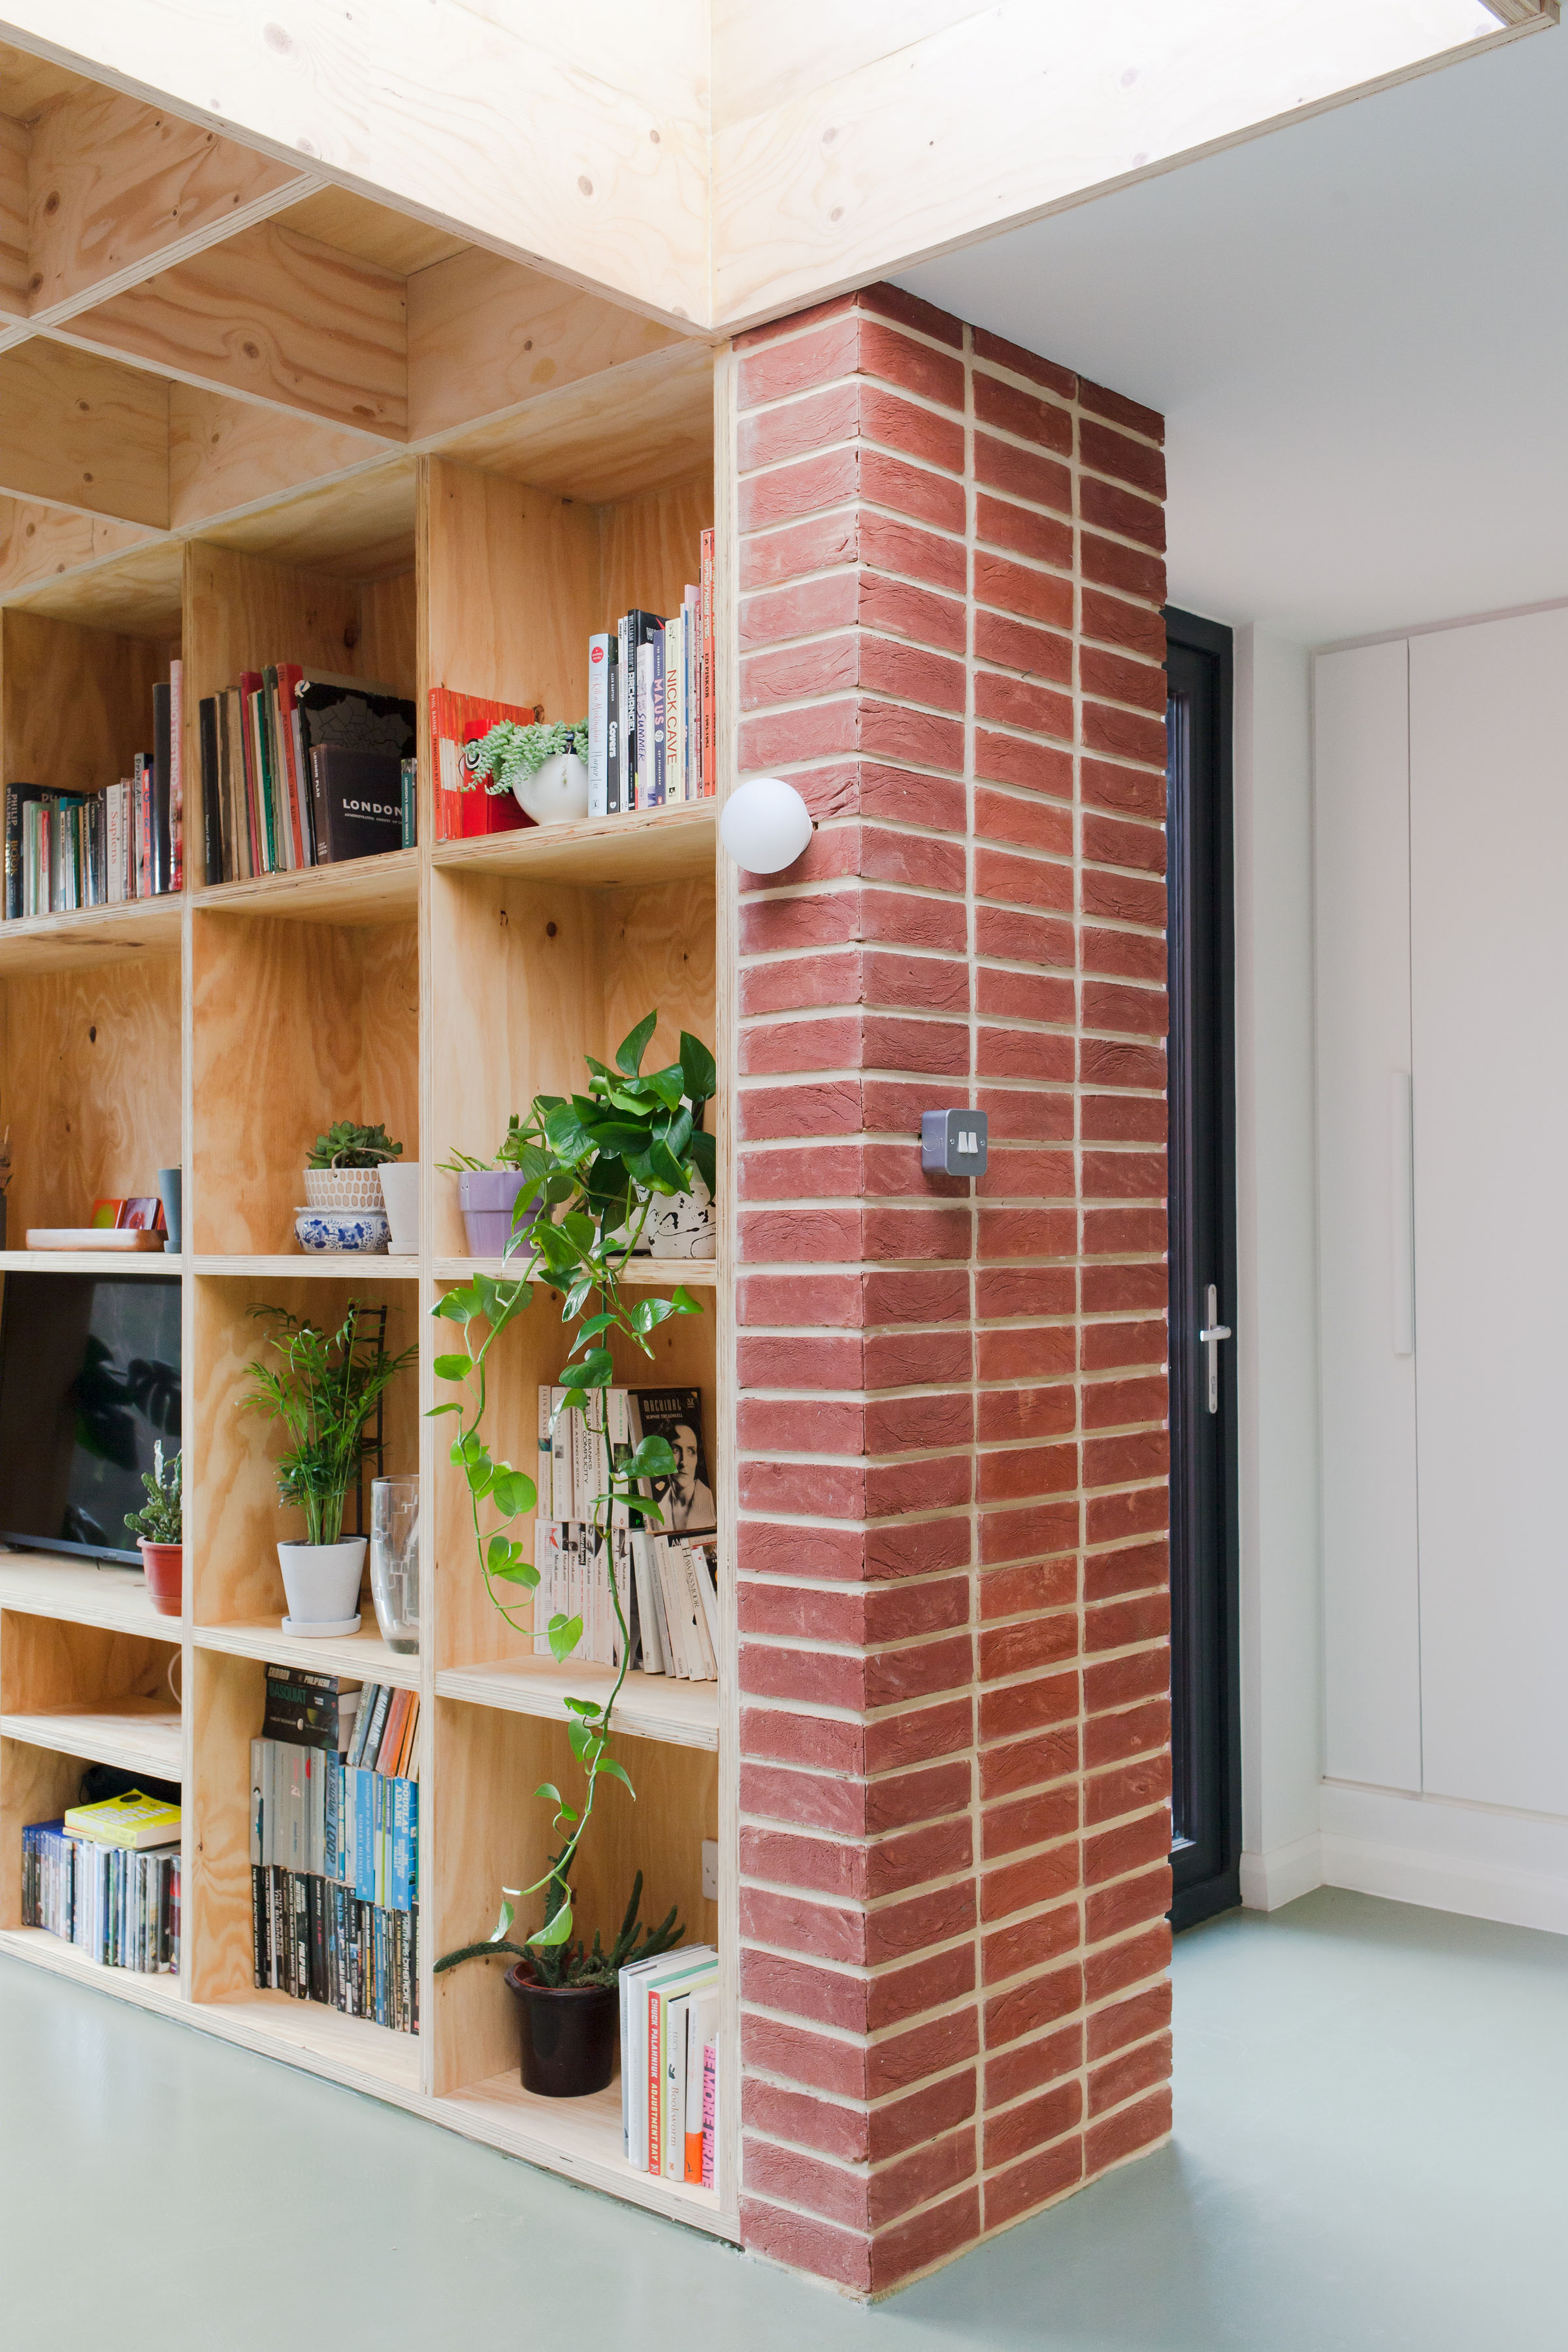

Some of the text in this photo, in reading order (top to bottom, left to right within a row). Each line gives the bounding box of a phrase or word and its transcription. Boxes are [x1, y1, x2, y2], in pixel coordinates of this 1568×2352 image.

[593, 672, 602, 680] To
[705, 653, 710, 664] ED
[592, 683, 602, 694] Kill
[654, 678, 664, 725] MAUS
[591, 702, 602, 742] Mockingbird
[667, 669, 677, 765] NICK CAVE
[609, 721, 618, 758] Covers
[637, 712, 647, 762] SUMMER
[434, 773, 439, 781] BY
[591, 751, 602, 789] Harper Lee
[342, 798, 402, 816] LONDON
[108, 811, 119, 864] Sapiens
[10, 840, 19, 877] BOOK
[643, 1399, 681, 1413] MACHINAL
[575, 1457, 580, 1467] OF
[682, 1548, 700, 1609] HAWKSMOOR
[269, 1682, 307, 1705] BASQUIAT
[394, 1784, 402, 1827] ADAMS
[326, 1820, 336, 1865] LOOP
[289, 1904, 294, 1915] ON
[298, 1965, 306, 1985] KERR
[650, 2027, 659, 2078] PALAHNIUK
[633, 2067, 638, 2076] TO
[670, 2086, 679, 2147] Bookworm
[702, 2047, 715, 2189] BE MORE PIRATE
